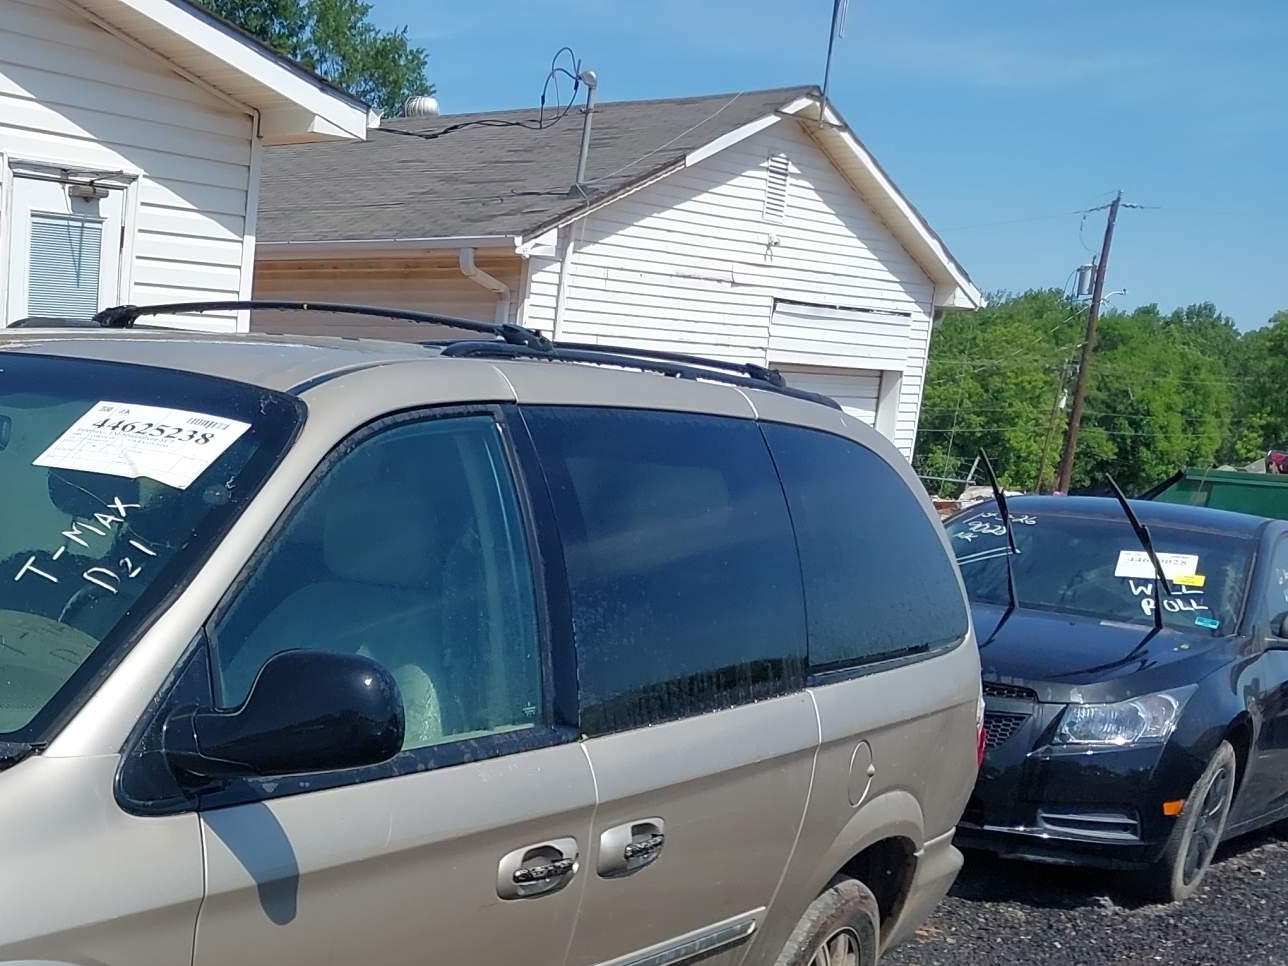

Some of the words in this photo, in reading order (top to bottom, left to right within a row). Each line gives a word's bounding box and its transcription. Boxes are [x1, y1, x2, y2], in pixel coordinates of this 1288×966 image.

[92, 417, 215, 446] 44625238
[14, 496, 141, 584] T-MAX
[82, 539, 158, 595] D21
